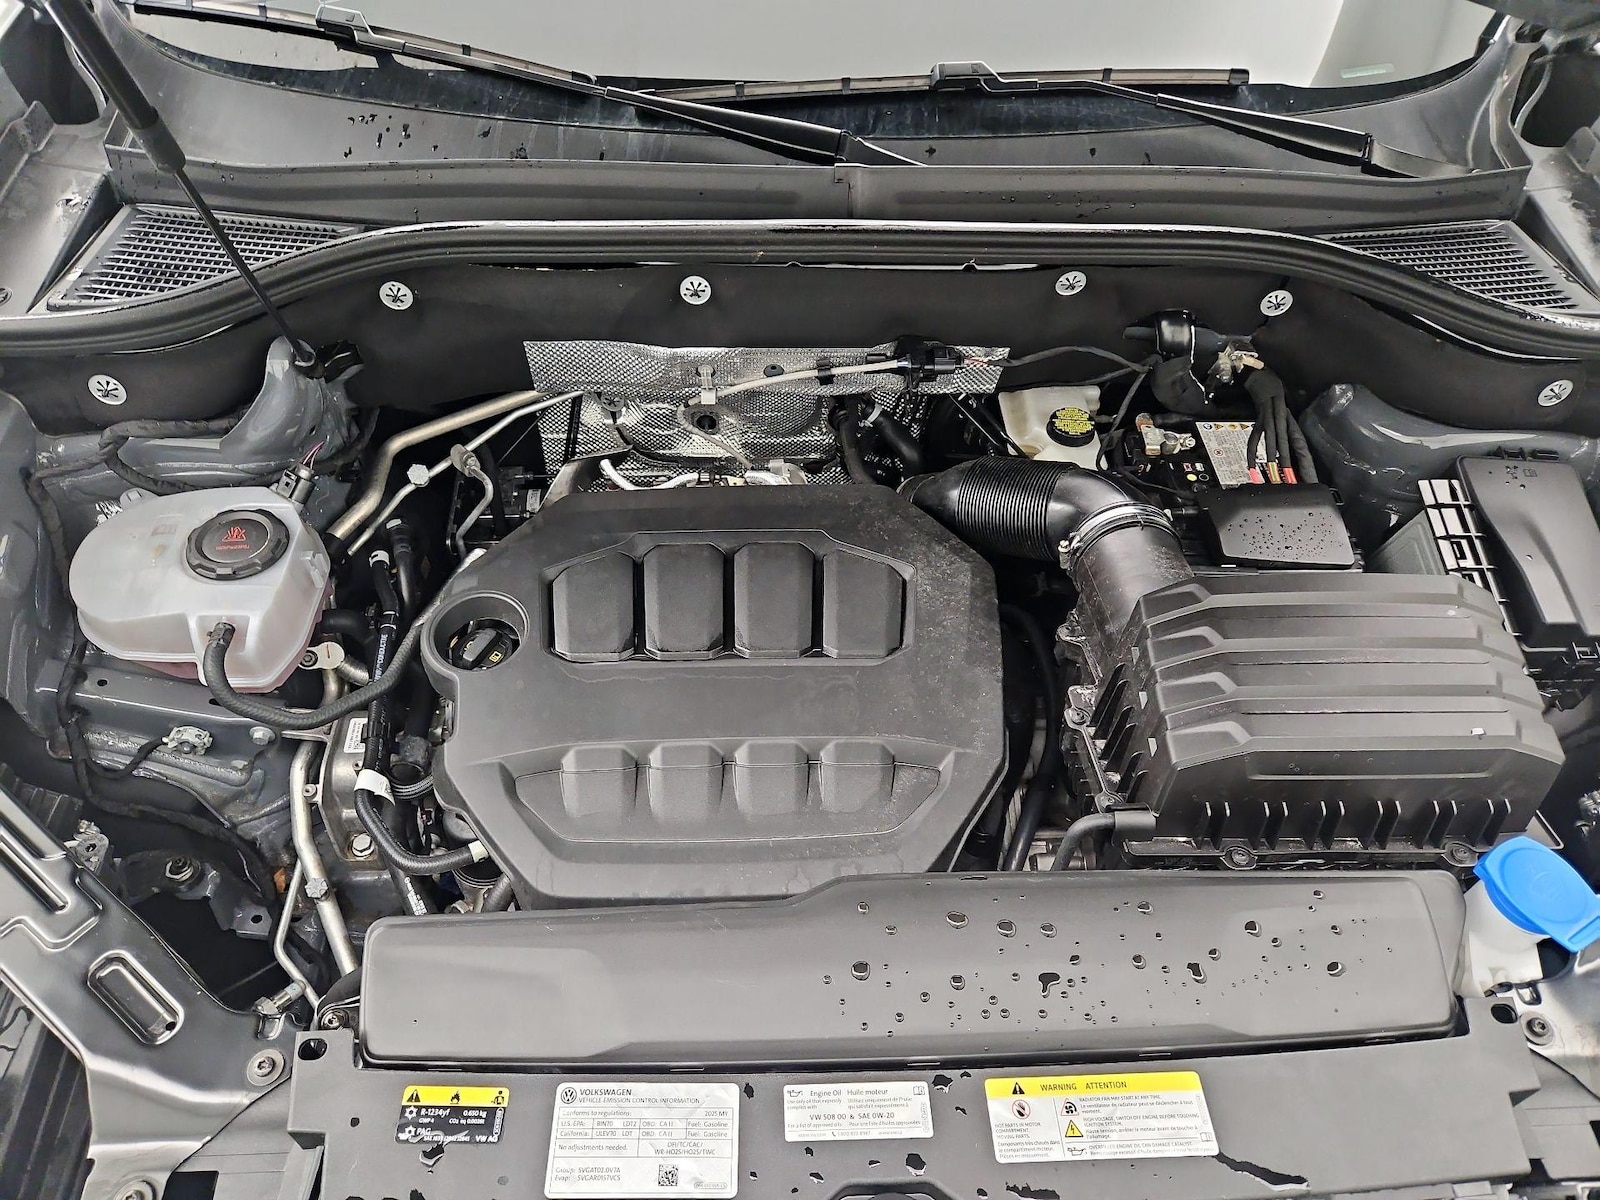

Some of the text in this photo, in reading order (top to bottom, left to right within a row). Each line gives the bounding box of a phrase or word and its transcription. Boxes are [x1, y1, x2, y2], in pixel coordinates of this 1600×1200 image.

[1040, 1081, 1127, 1091] WARNING ATTENTION
[579, 1088, 632, 1096] VOLKSWAGEN
[810, 1090, 832, 1099] Engine
[832, 1089, 842, 1097] Oil
[421, 1108, 450, 1118] R-1234yf
[479, 1110, 487, 1119] kg
[823, 1113, 836, 1121] 508
[416, 1127, 431, 1136] PAG
[568, 1144, 604, 1152] adjustments
[554, 1174, 571, 1183] Evap:
